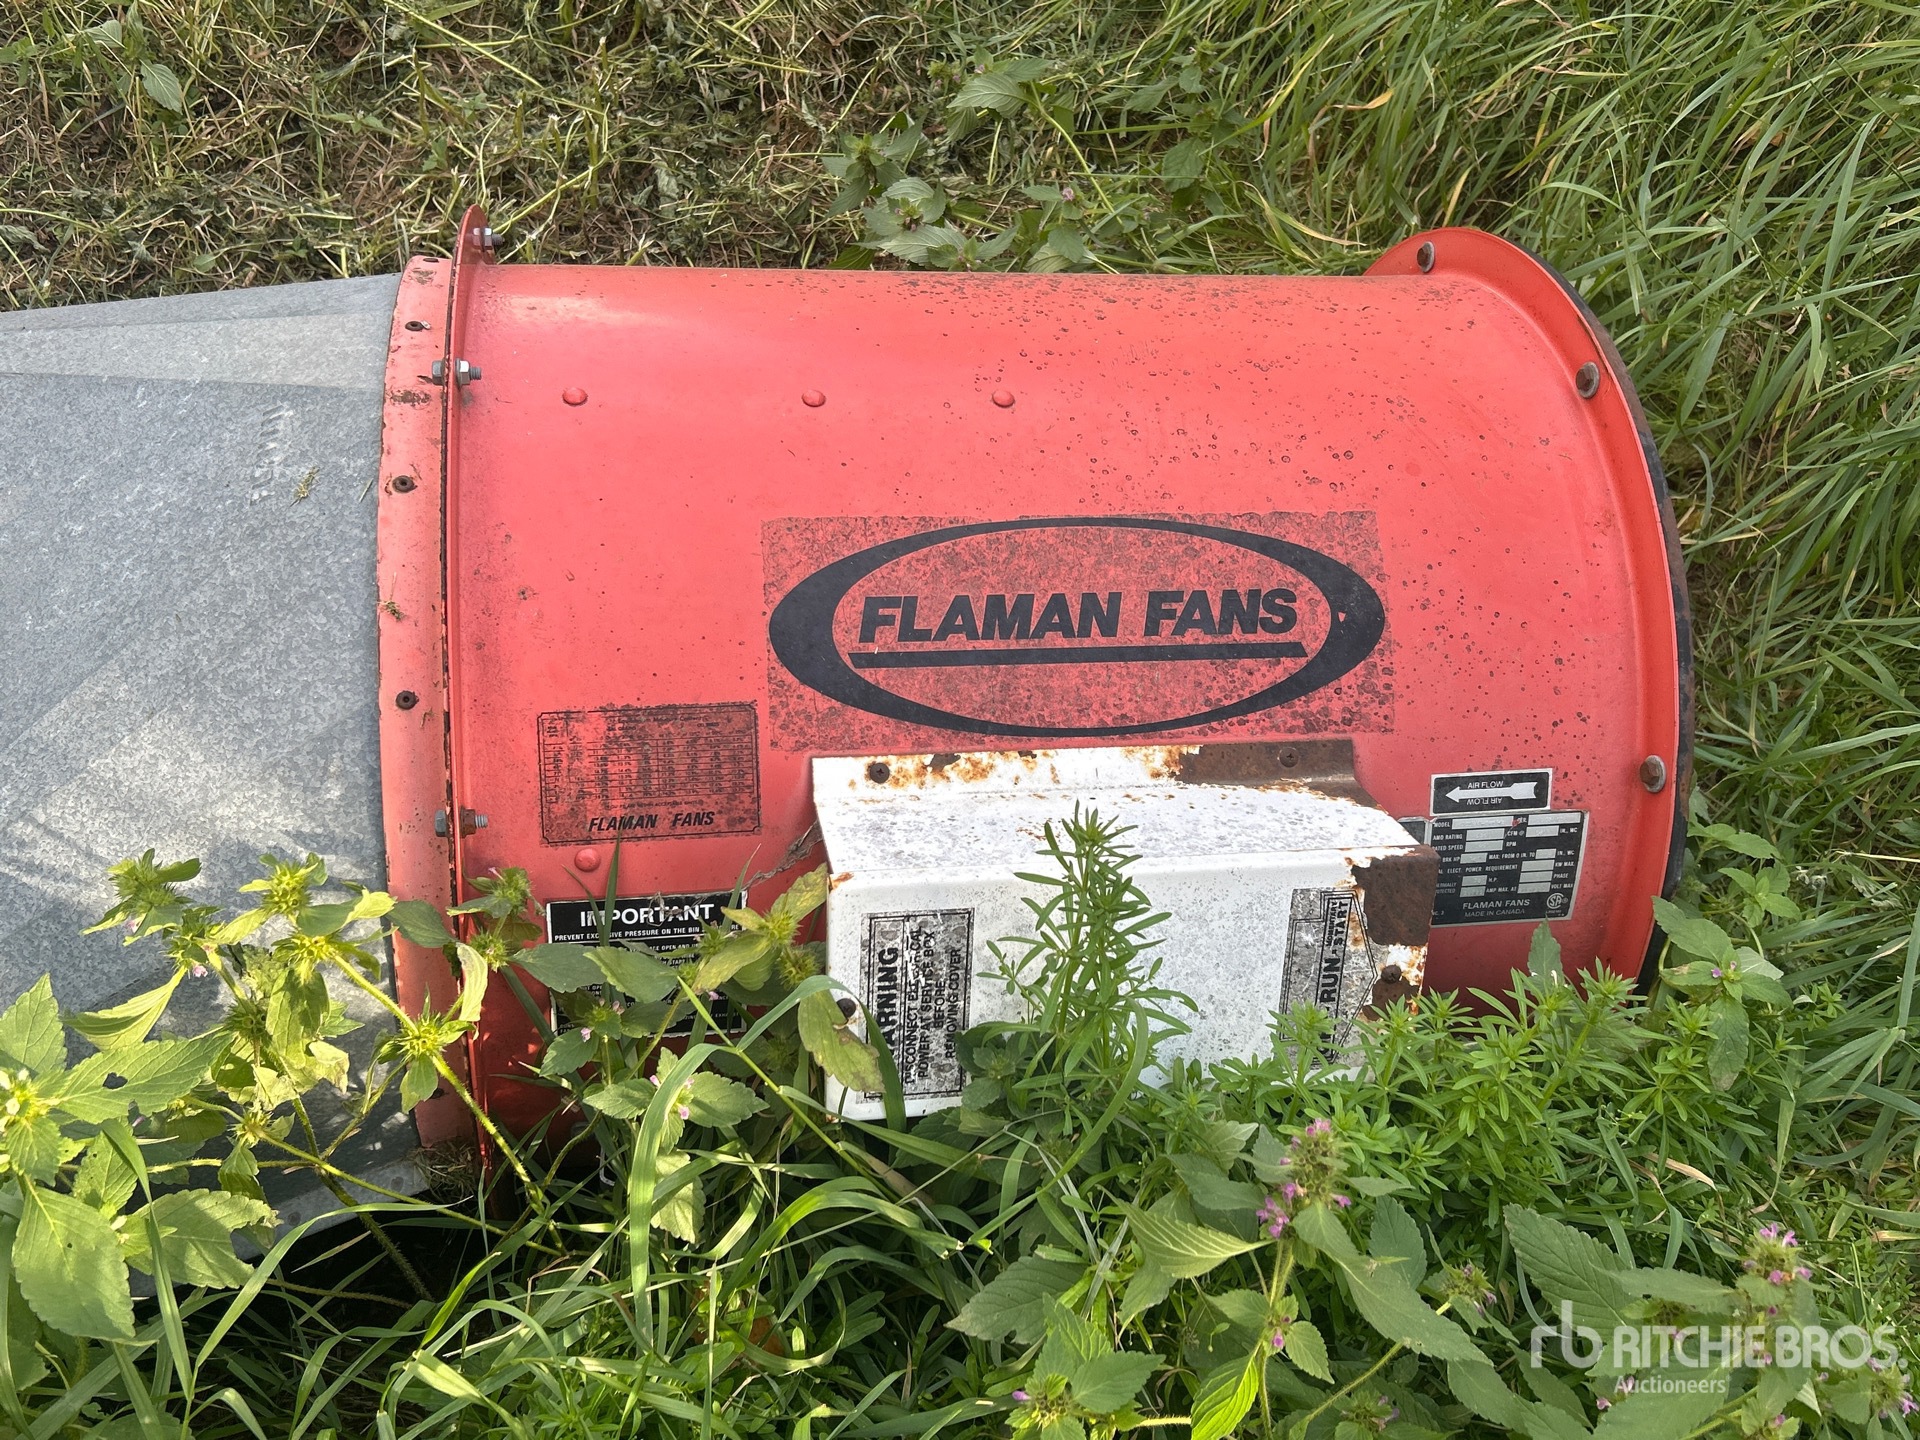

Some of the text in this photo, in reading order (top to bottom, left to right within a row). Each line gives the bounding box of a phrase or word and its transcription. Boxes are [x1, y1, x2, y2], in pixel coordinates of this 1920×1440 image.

[858, 588, 1297, 644] FLAMAN FANS
[588, 811, 716, 832] FLAMAN FANS
[1485, 864, 1518, 872] REQUIREMENT
[580, 904, 715, 927] IMPORTANT
[1325, 901, 1338, 947] MOMENTARY
[1333, 901, 1349, 946] START
[1462, 899, 1531, 910] FLAMAN FANS
[554, 933, 585, 941] PREVENT
[586, 931, 623, 939] EXCSIVE
[624, 929, 659, 937] PRESSURE
[876, 947, 899, 1056] ARNING
[1319, 958, 1341, 1003] RUN
[918, 931, 935, 1078] POWER AT SERVICE BOX
[933, 981, 946, 1028] BEFORE
[944, 949, 961, 1058] REMOVING COVER
